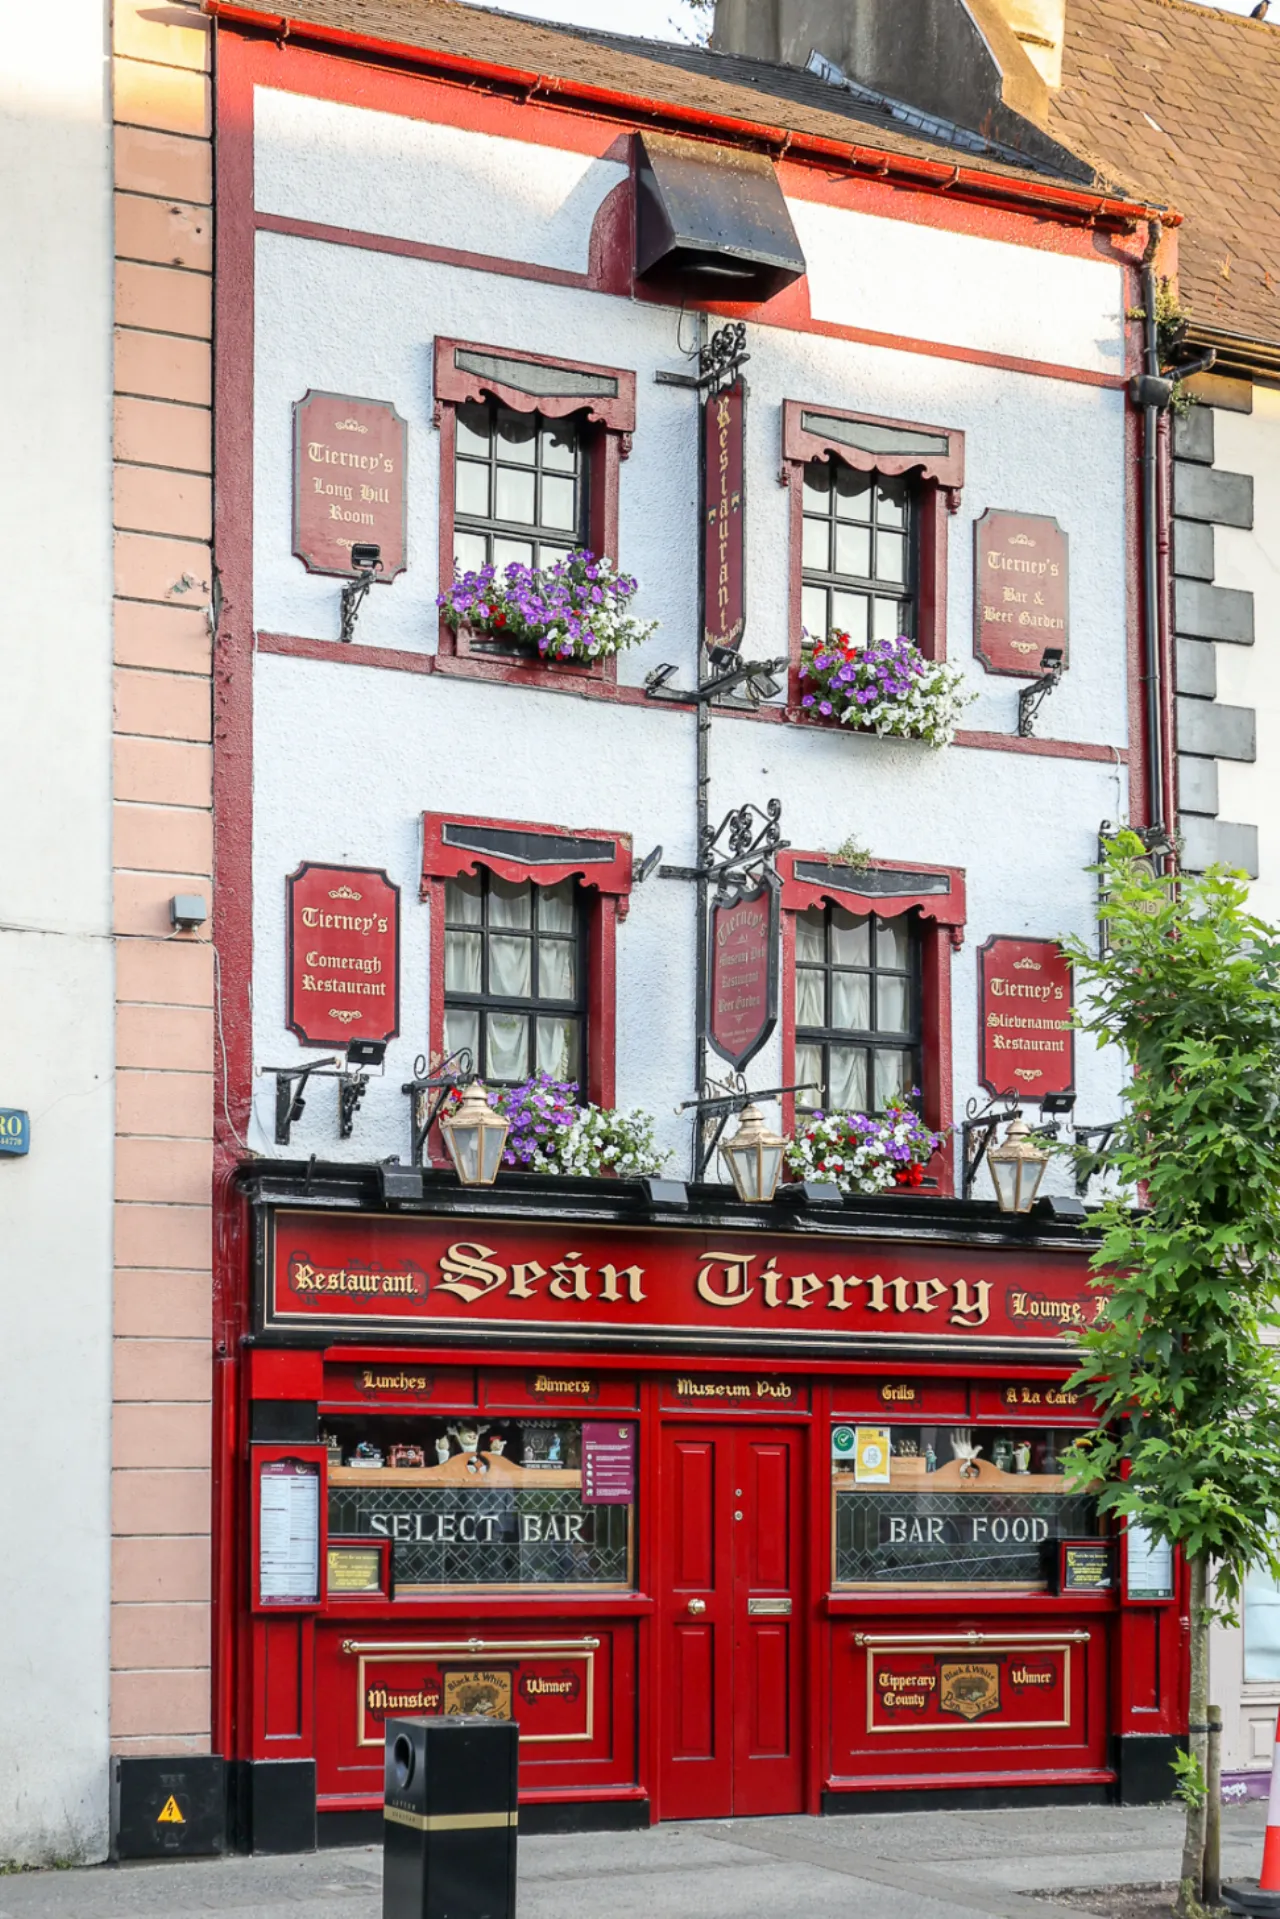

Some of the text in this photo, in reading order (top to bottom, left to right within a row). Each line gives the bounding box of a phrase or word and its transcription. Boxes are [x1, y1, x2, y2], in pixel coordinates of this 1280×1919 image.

[308, 441, 394, 475] Tierney's
[312, 477, 390, 504] Long Hill
[329, 503, 375, 525] Room
[716, 396, 732, 633] Restaurant
[987, 551, 1060, 578] Tierney's
[1002, 586, 1045, 606] Bar &
[983, 605, 1065, 630] Beer Garden
[301, 907, 389, 936] Tierney's
[305, 951, 382, 974] Comeragh
[301, 974, 387, 996] Restaurant
[990, 977, 1064, 1002] Tierney's
[992, 1033, 1065, 1052] Restaurant
[434, 1242, 647, 1303] Seán
[698, 1251, 993, 1326] Tierney
[363, 1371, 427, 1391] Lunches
[535, 1375, 591, 1393] Dinners
[677, 1378, 792, 1398] Museum Pub
[882, 1384, 915, 1400] Grills
[1006, 1387, 1079, 1404] A La Carte
[369, 1512, 586, 1544] SELECT BAR
[889, 1516, 1049, 1544] BAR FOOD
[447, 1671, 508, 1691] Black & White
[878, 1671, 937, 1692] Tipperary
[943, 1663, 995, 1681] Black & White
[1011, 1666, 1052, 1685] Winner
[526, 1677, 573, 1694] Winner
[367, 1689, 440, 1709] Munster
[883, 1692, 925, 1708] County
